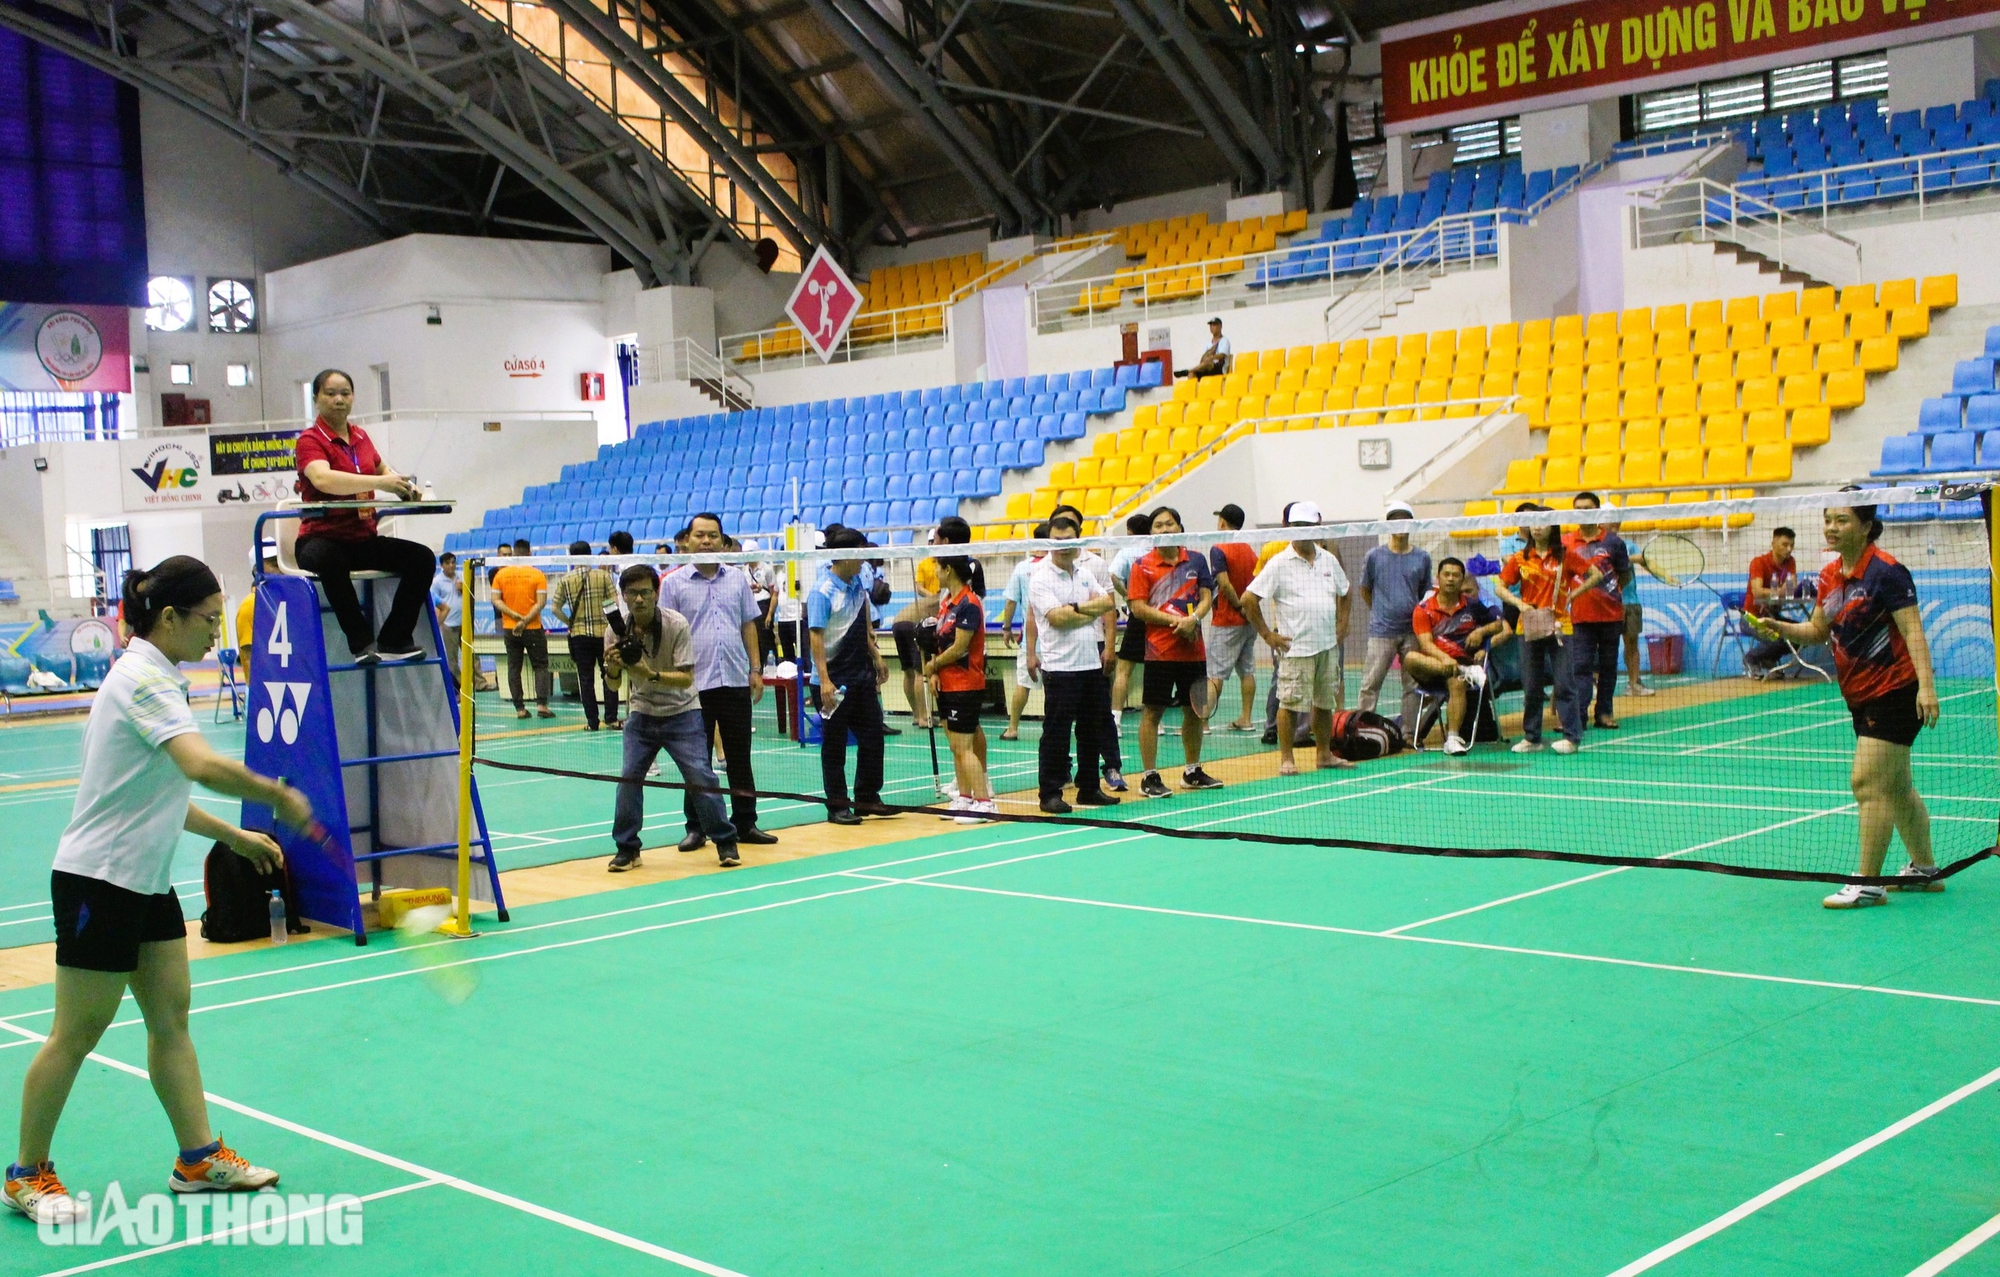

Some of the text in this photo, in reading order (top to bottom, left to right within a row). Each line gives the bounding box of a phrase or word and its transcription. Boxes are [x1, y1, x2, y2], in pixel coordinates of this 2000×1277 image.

[1409, 34, 1487, 104] KHỎE
[1496, 18, 1537, 88] ĐỂ
[1547, 17, 1610, 79] XÂY
[1621, 2, 1717, 70] DỰNG
[131, 456, 198, 493] VHC
[268, 601, 292, 668] 4
